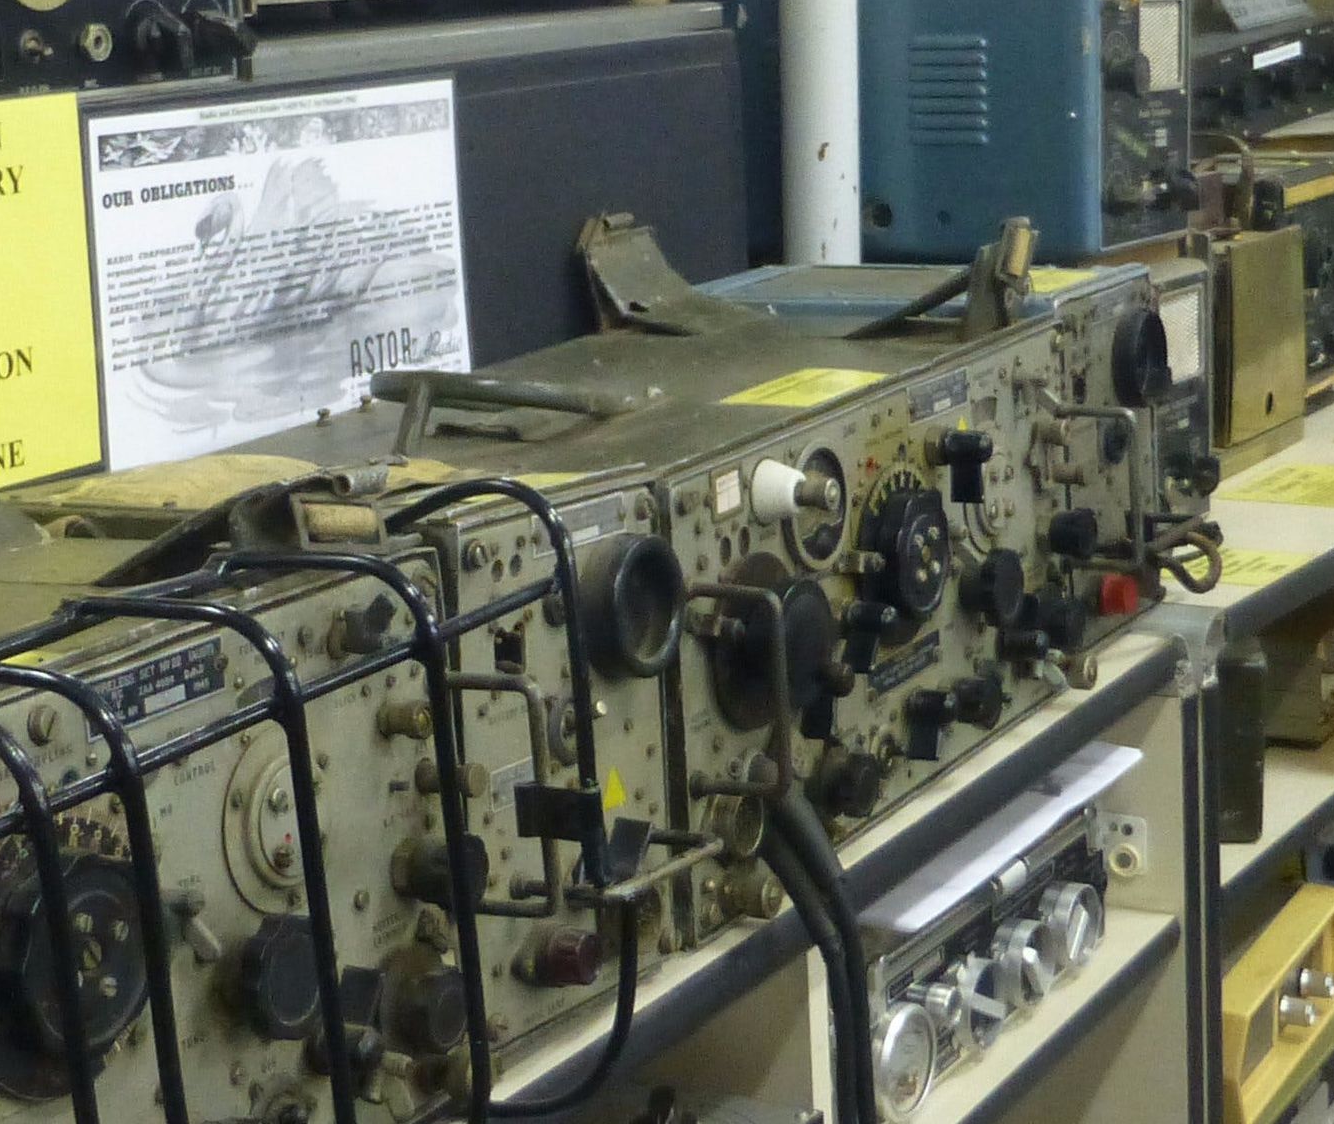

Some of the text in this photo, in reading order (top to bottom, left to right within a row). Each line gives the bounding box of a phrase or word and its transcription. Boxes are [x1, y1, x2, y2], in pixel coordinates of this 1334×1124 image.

[103, 175, 236, 208] OUR OBLIGATIONS
[350, 328, 412, 378] ASTOR
